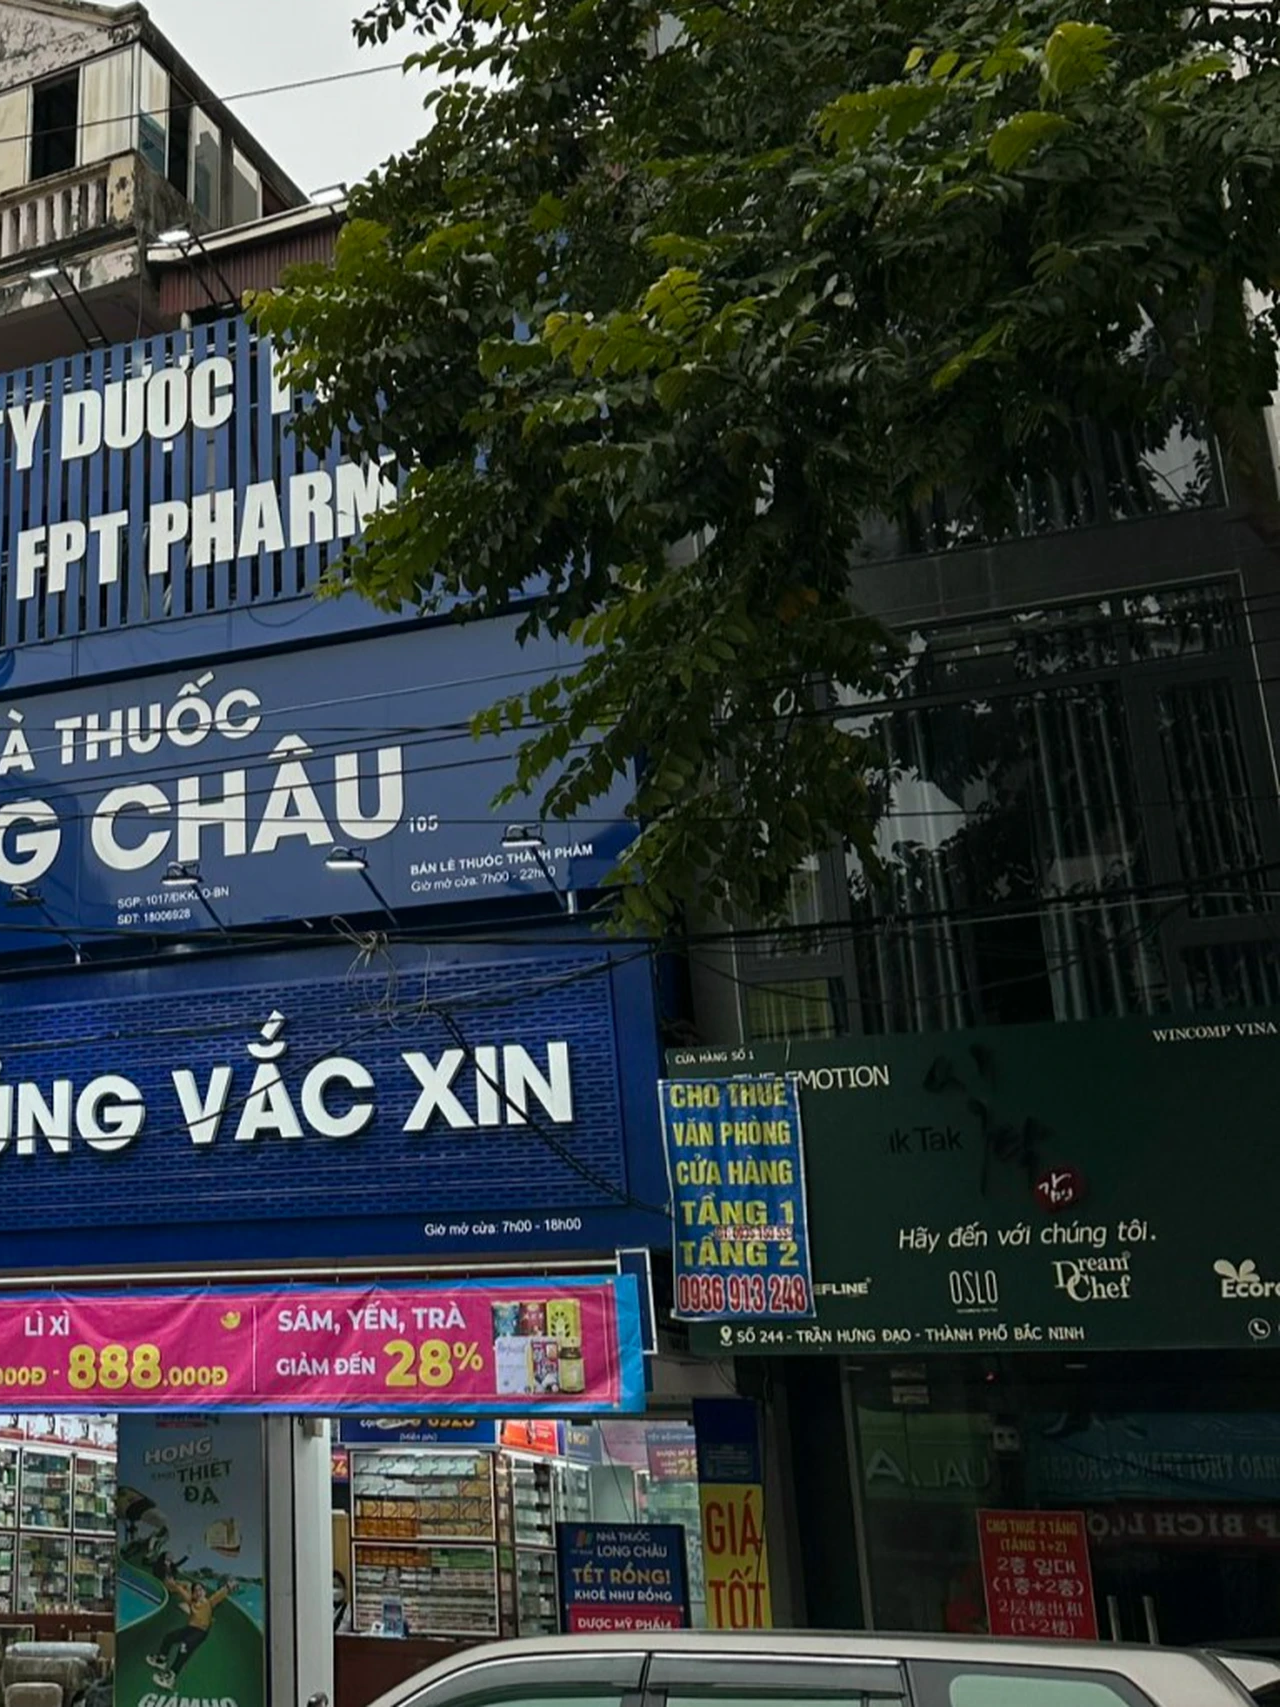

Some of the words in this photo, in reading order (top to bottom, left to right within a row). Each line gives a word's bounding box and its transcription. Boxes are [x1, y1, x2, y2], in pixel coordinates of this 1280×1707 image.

[61, 355, 234, 461] DƯỢC
[17, 510, 128, 600] FPT
[148, 452, 398, 576] PHARM
[55, 671, 262, 765] THUỐC
[91, 733, 403, 870] CHÂU
[410, 861, 436, 875] BÁN
[460, 852, 503, 869] THUỐC
[411, 880, 431, 892] Giờ
[481, 872, 509, 885] 7h00
[1152, 1025, 1230, 1042] WINCOMP
[1235, 1022, 1277, 1036] VINA
[700, 1051, 727, 1063] HÀNG
[171, 1010, 375, 1145] VẮC
[402, 1040, 573, 1134] XIN
[670, 1083, 720, 1108] CHO
[726, 1079, 789, 1108] THUÊ
[672, 1117, 714, 1147] VĂN
[721, 1116, 791, 1146] PHÒNG
[676, 1153, 722, 1185] CỬA
[727, 1156, 794, 1185] HÀNG
[680, 1191, 768, 1225] TẦNG
[780, 1200, 795, 1225] 1
[424, 1222, 446, 1236] Giờ
[502, 1220, 532, 1233] 7h00
[544, 1217, 582, 1232] 18h00
[898, 1227, 940, 1254] Hãy
[948, 1222, 988, 1248] đến
[997, 1225, 1031, 1246] với
[1040, 1221, 1107, 1248] chúng
[779, 1241, 800, 1267] 2
[678, 1274, 724, 1313] 0936
[729, 1274, 765, 1313] 913
[769, 1274, 807, 1313] 248
[949, 1269, 998, 1305] OSLO
[1067, 1273, 1131, 1302] Chef
[24, 1310, 43, 1336] LÌ
[49, 1310, 70, 1336] XÌ
[277, 1305, 341, 1334] SÂM,
[349, 1300, 406, 1333] YẾN,
[412, 1302, 466, 1330] TRÀ
[737, 1325, 756, 1343] SỐ
[760, 1330, 784, 1343] 244
[796, 1325, 832, 1343] TRẦN
[837, 1328, 876, 1342] HƯNG
[882, 1328, 912, 1344] ĐẠO
[925, 1324, 973, 1342] THÀNH
[978, 1322, 1008, 1341] PHỐ
[1014, 1322, 1042, 1341] BẮC
[1048, 1326, 1084, 1341] NINH
[276, 1354, 329, 1377] GIẢM
[335, 1353, 376, 1376] ĐẾN
[382, 1338, 484, 1388] 28%
[705, 1490, 759, 1556] GIÁ
[987, 1519, 1007, 1533] CHO
[597, 1545, 631, 1557] LONG
[633, 1542, 667, 1558] CHÂU
[571, 1561, 604, 1583] TẾT
[708, 1566, 765, 1630] TỐT
